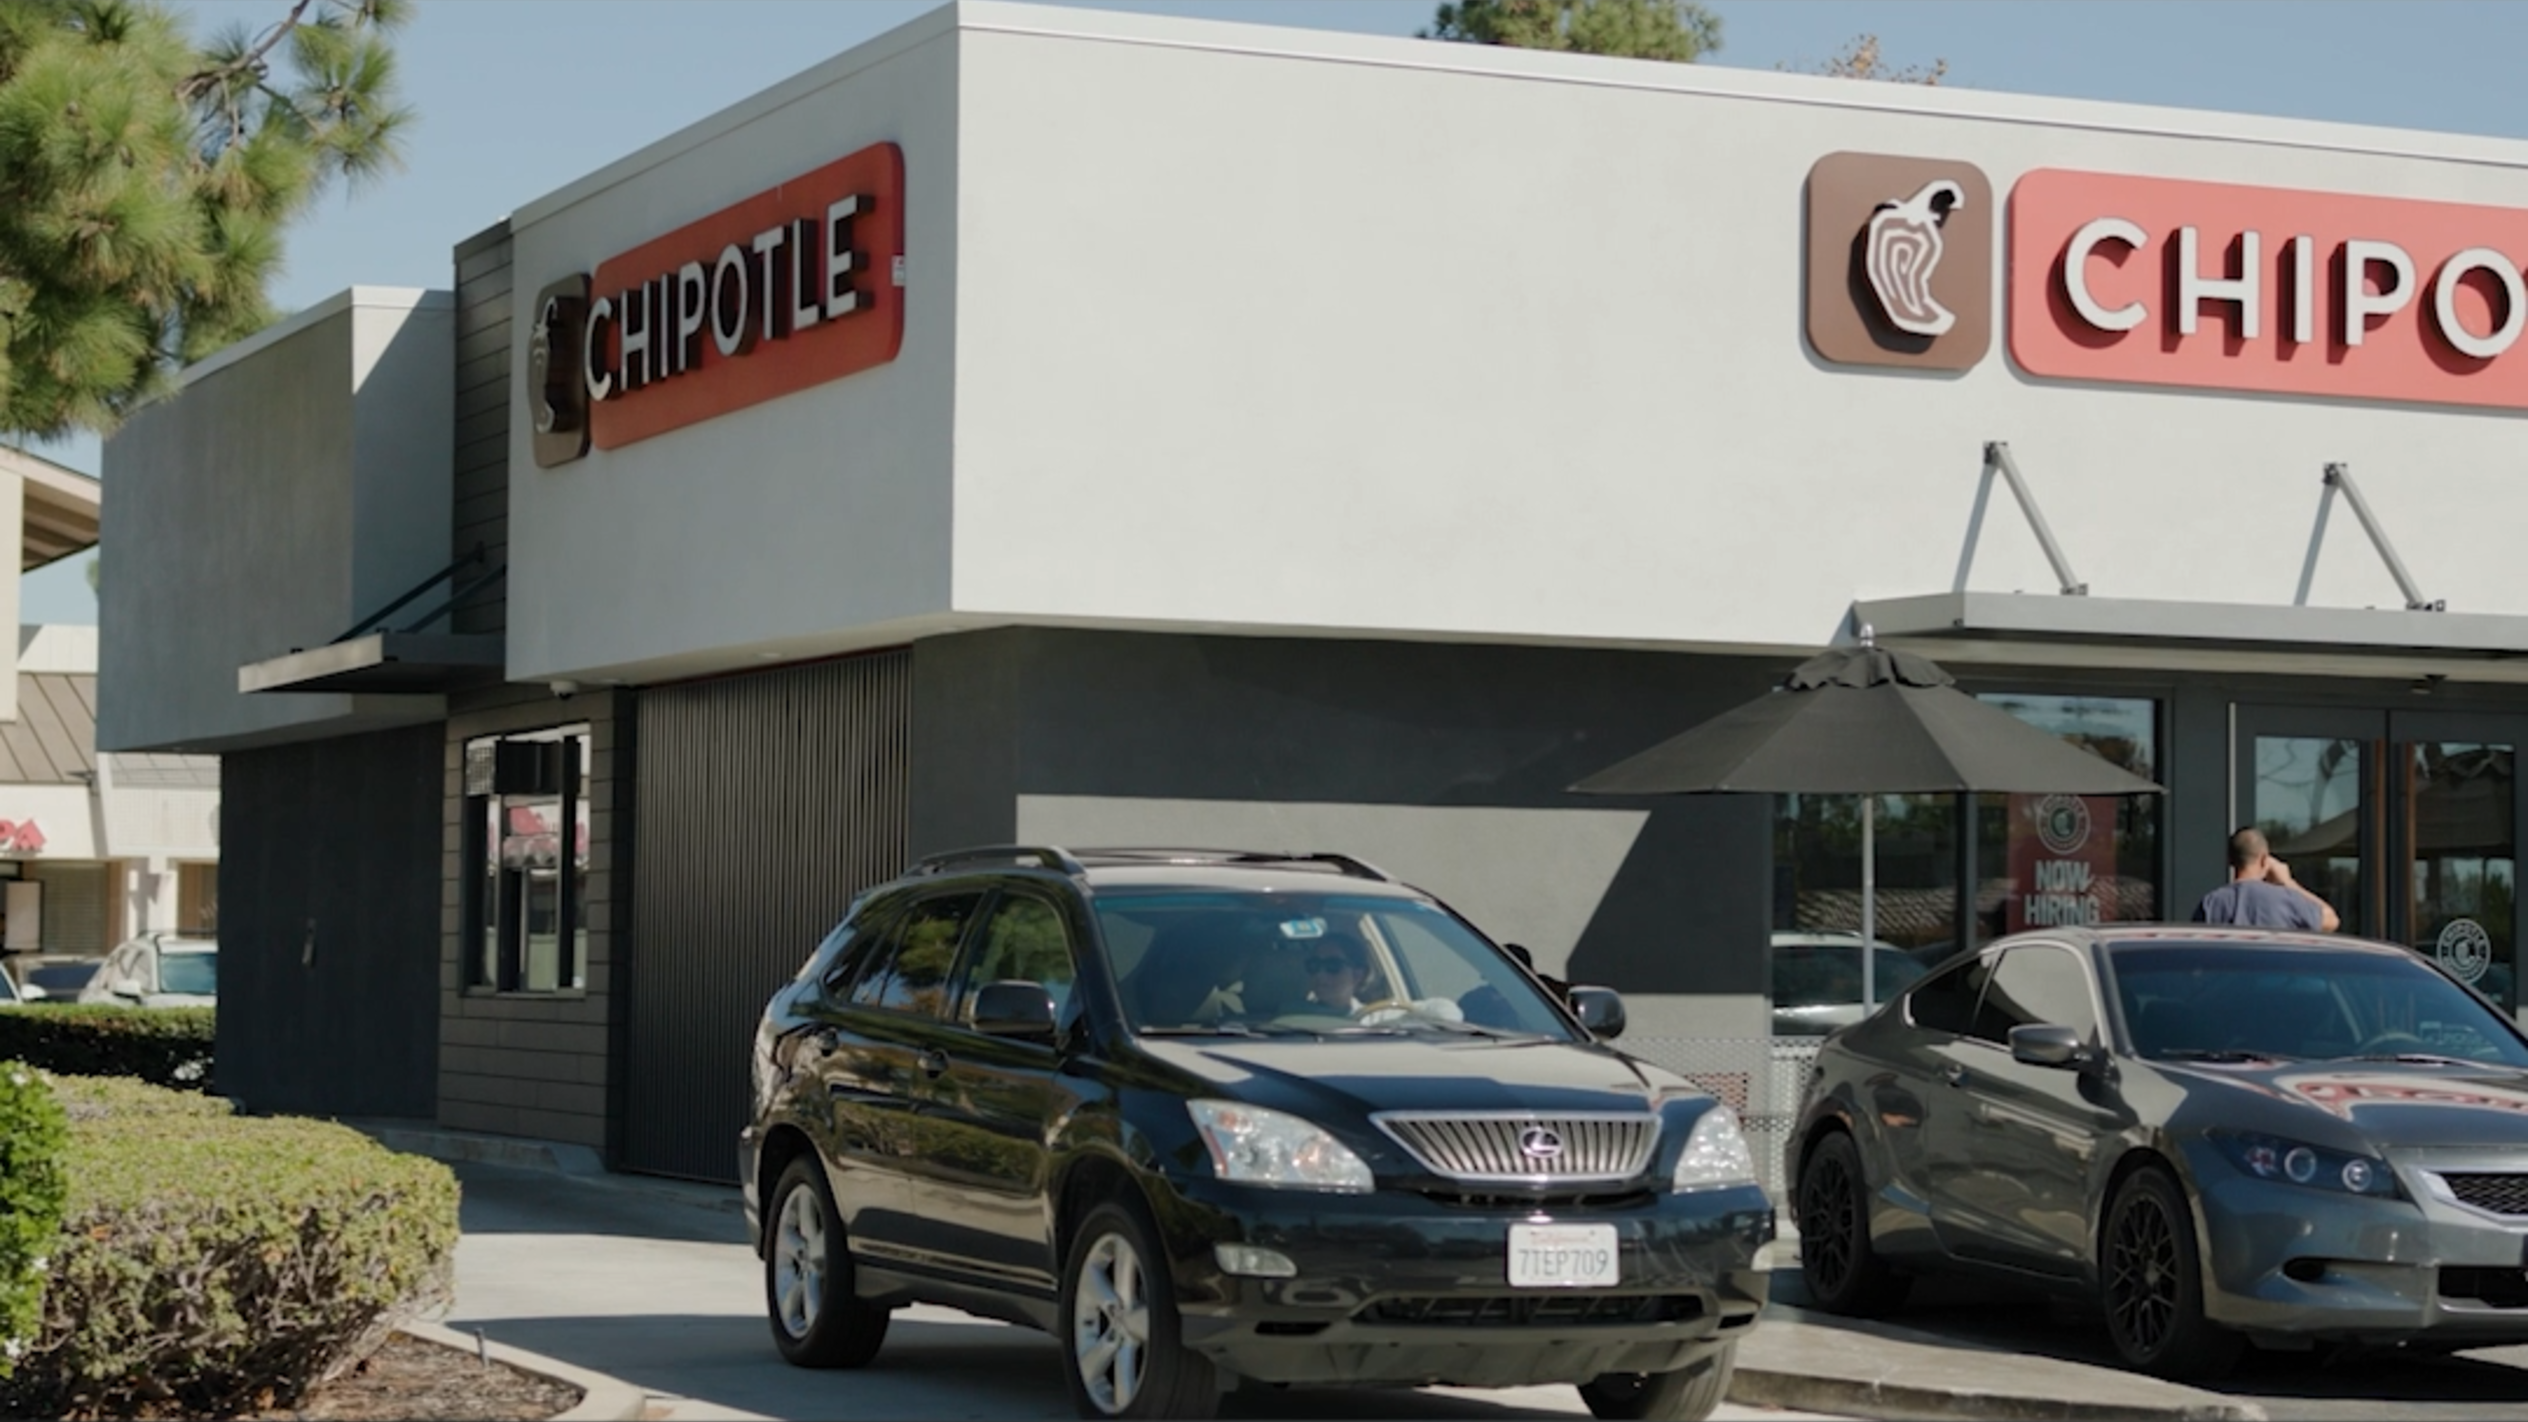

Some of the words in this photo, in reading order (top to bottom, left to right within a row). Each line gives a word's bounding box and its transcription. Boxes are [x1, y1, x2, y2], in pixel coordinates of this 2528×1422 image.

[585, 194, 857, 401] CHIPOTLE
[2035, 859, 2090, 893] NOW
[2024, 893, 2100, 926] HIRING
[1518, 1248, 1609, 1277] 7TEP709
